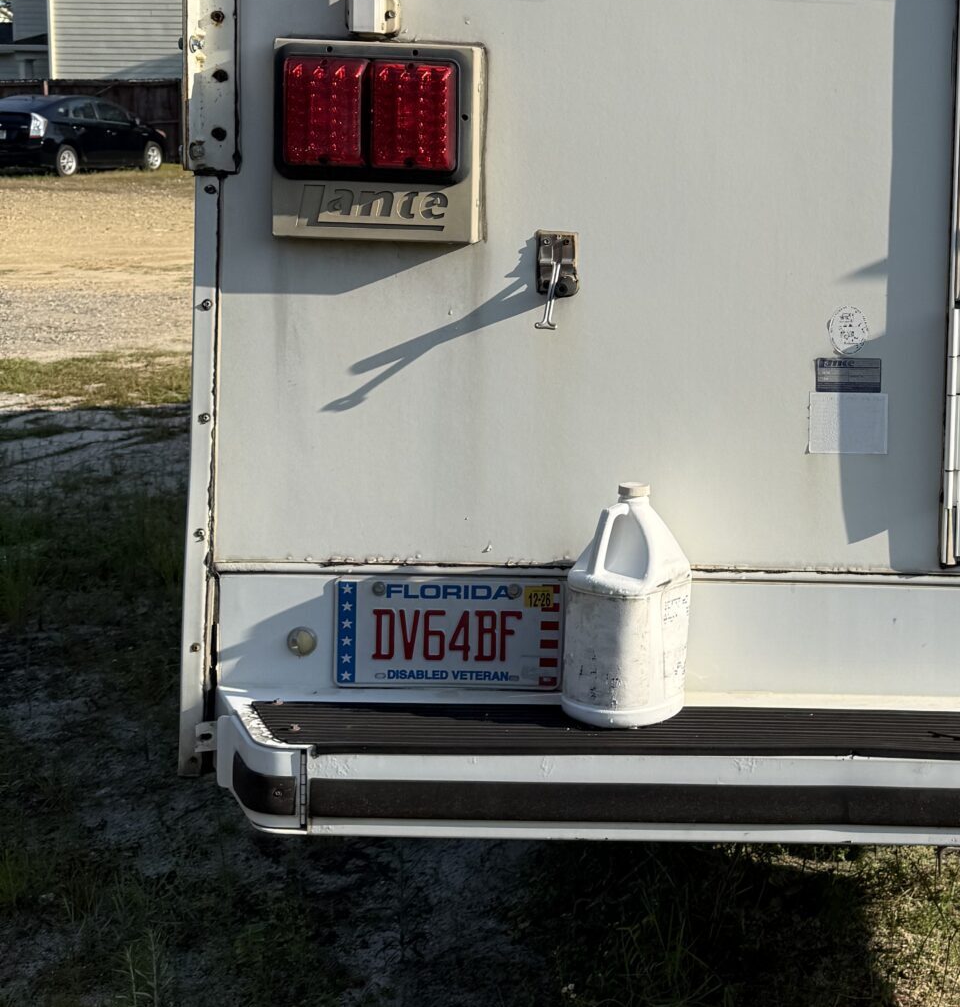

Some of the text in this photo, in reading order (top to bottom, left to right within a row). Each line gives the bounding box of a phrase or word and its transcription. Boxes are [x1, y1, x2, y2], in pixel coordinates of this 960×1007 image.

[386, 584, 514, 600] FLORIDA
[372, 609, 523, 662] DV64BF
[387, 669, 510, 682] DISABLED VETERAN
